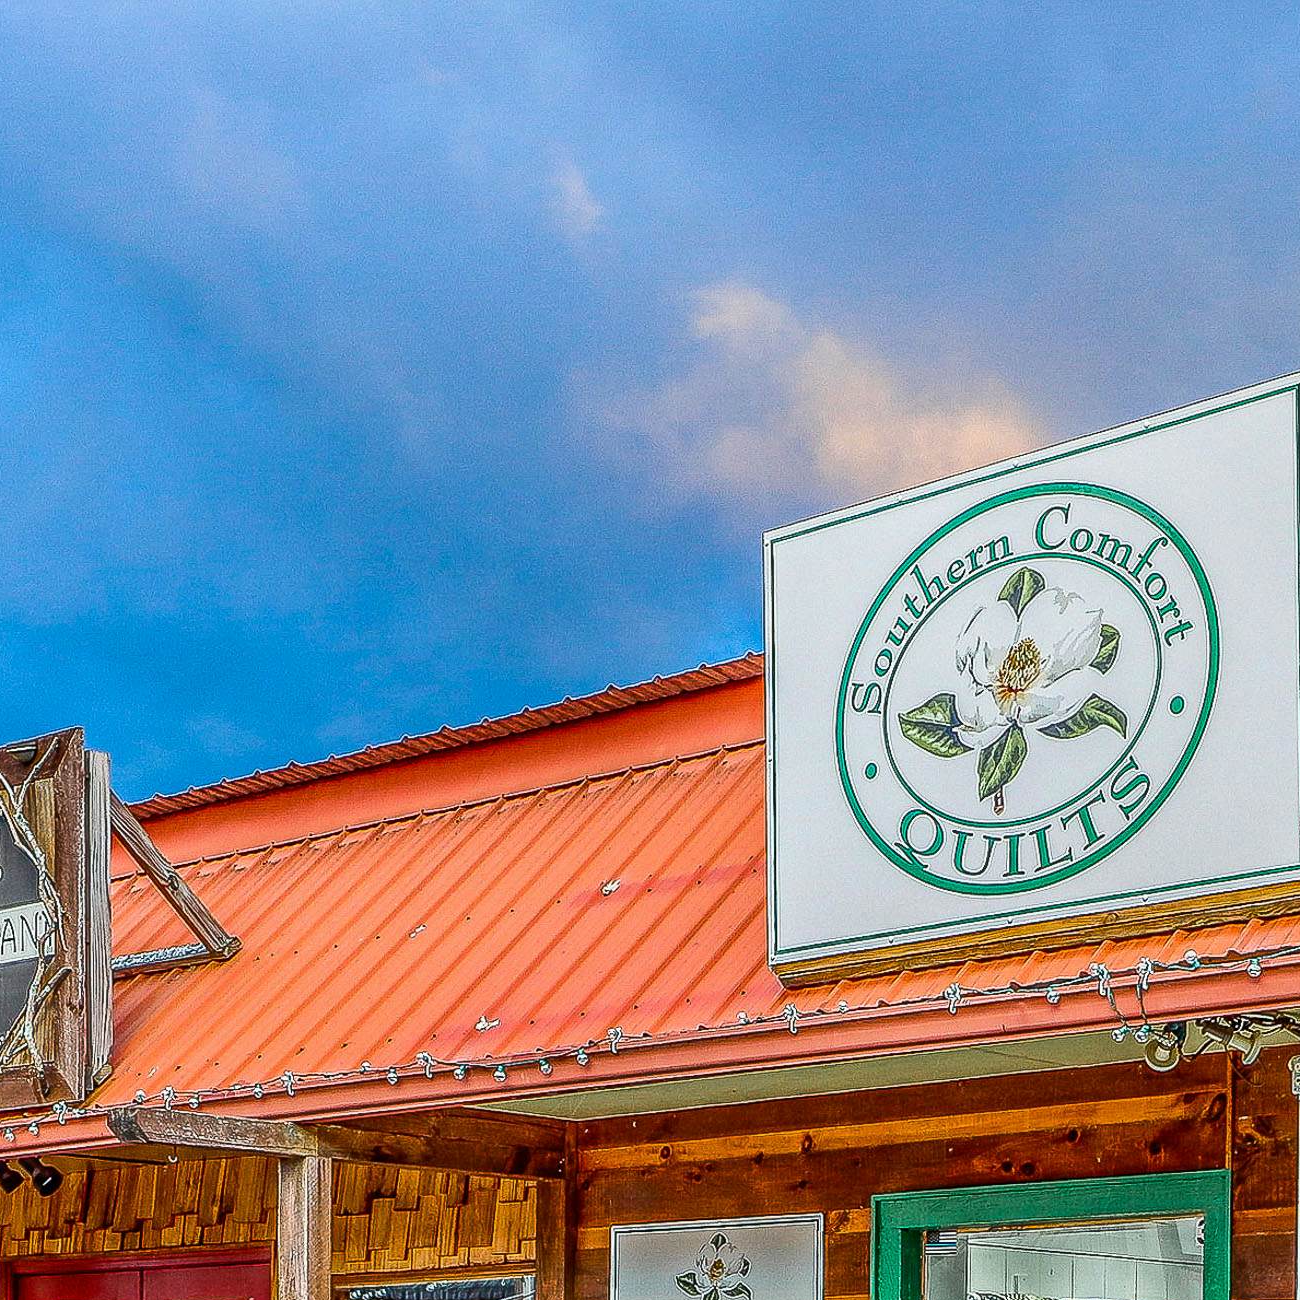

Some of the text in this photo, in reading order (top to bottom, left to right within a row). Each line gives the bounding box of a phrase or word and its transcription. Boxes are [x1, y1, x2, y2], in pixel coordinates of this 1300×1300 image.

[851, 502, 1194, 716] Southern Comfort
[894, 755, 1152, 878] QUILTS
